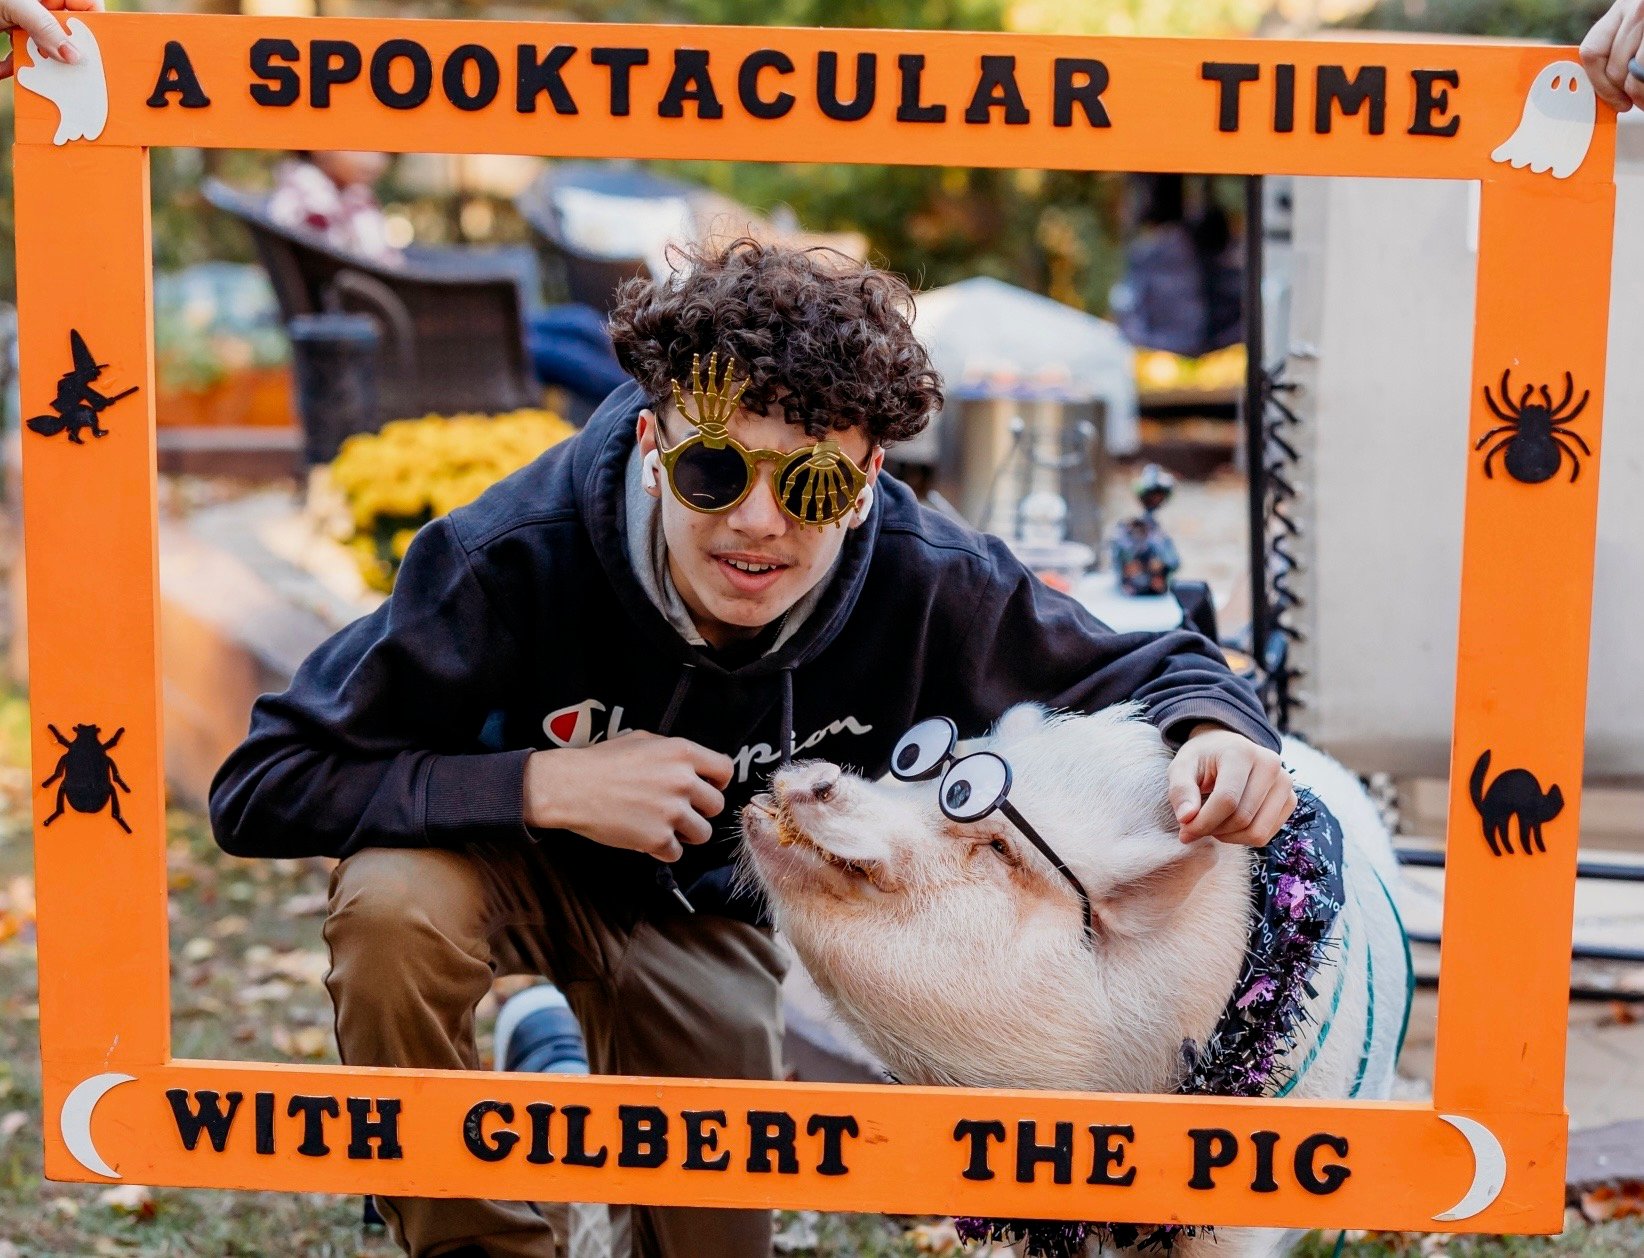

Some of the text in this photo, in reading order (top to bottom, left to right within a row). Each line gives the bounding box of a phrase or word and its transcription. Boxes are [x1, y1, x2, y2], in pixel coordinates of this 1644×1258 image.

[146, 38, 1461, 138] A SPOOKTACULAR TIME
[542, 699, 873, 783] Chpion
[165, 1088, 1352, 1196] WITH GILBERT THE PIG
